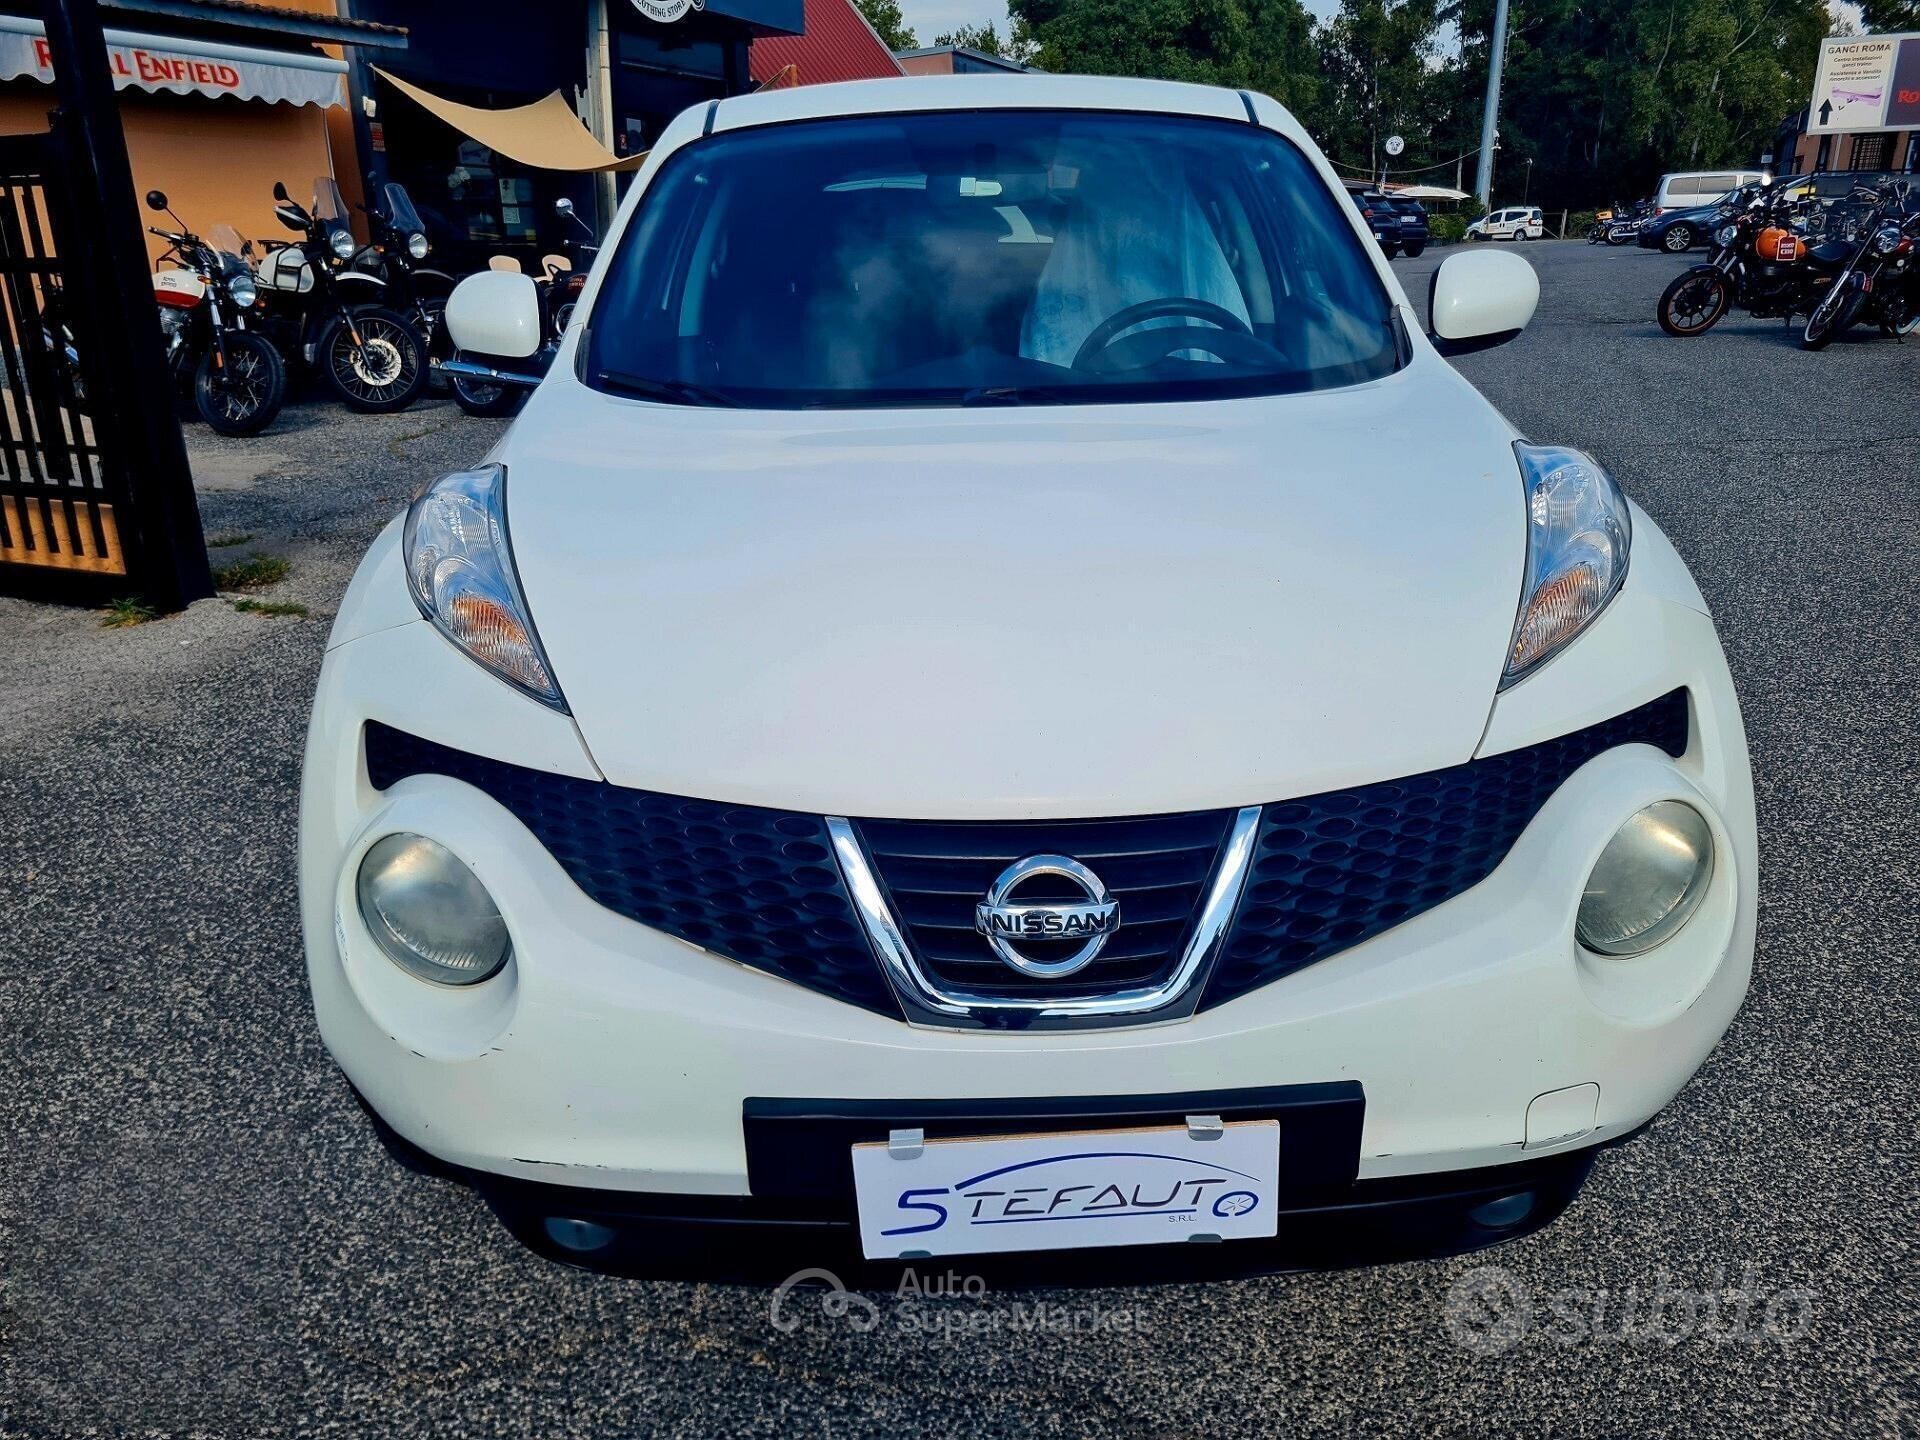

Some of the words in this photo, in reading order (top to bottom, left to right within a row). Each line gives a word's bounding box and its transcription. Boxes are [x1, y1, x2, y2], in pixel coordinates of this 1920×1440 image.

[636, 0, 667, 18] LOTHING
[667, 0, 686, 17] STORE
[1828, 45, 1860, 54] GANCI
[1862, 43, 1892, 53] ROMA
[134, 49, 240, 88] ENFIELD
[991, 911, 1106, 934] NISSAN
[880, 1178, 1259, 1237] STEFAUTO
[1168, 1214, 1198, 1224] S.R.L.
